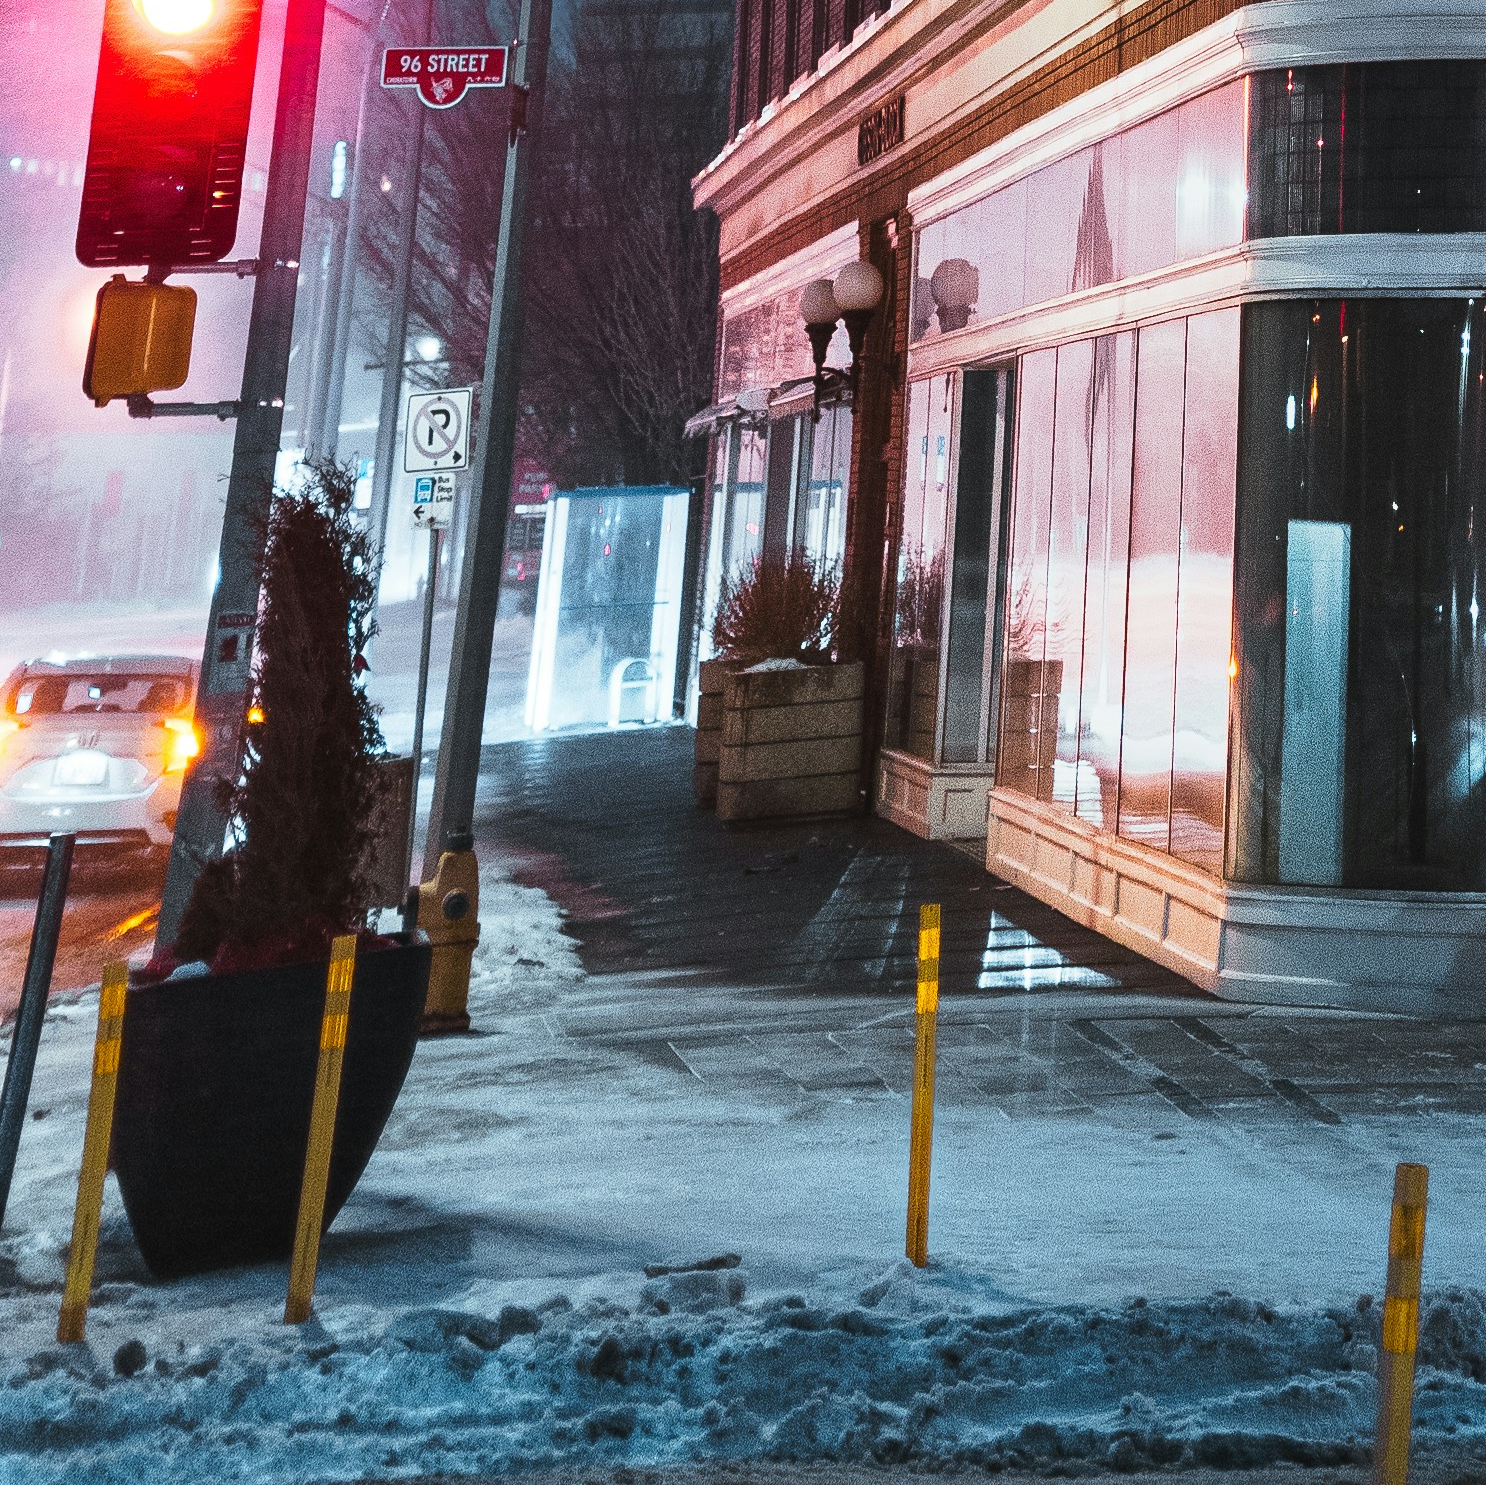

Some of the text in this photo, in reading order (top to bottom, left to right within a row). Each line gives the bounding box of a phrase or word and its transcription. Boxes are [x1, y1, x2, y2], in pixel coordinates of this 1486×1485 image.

[400, 54, 489, 73] 96 STREET
[437, 476, 450, 484] Bus
[437, 486, 452, 494] Stop
[436, 495, 453, 503] Limit
